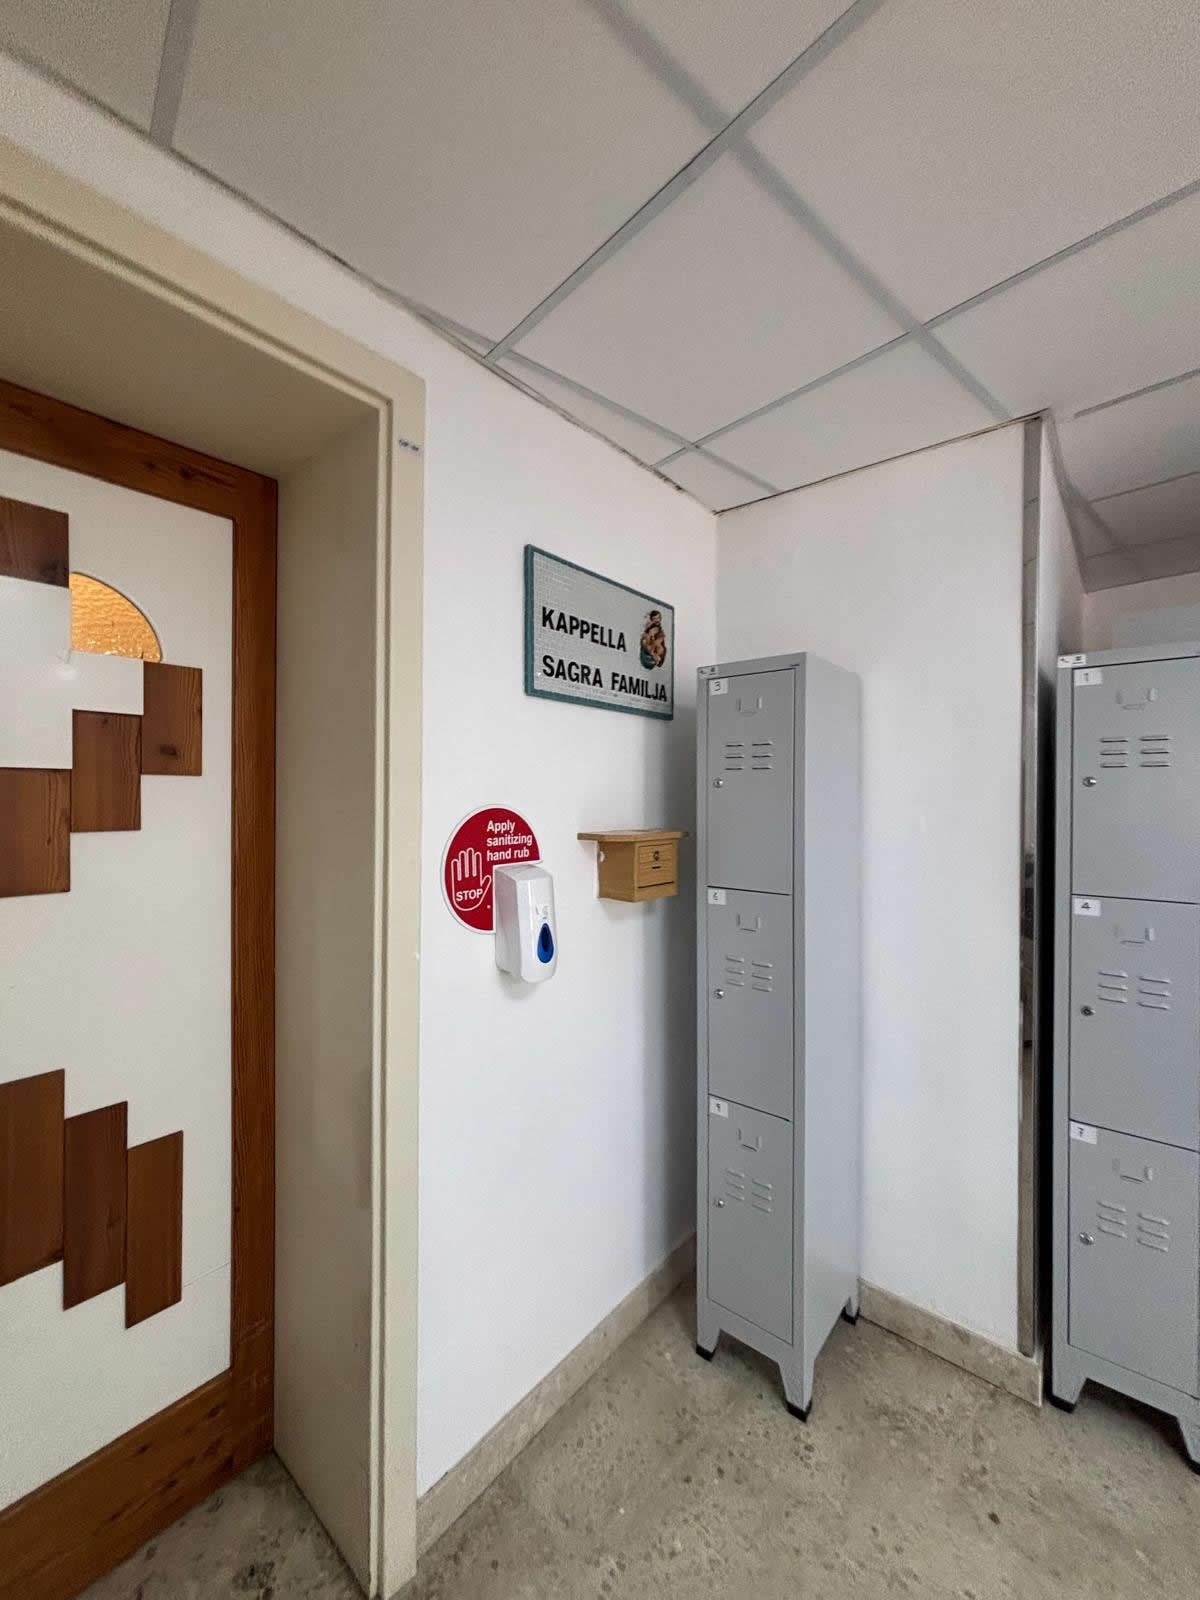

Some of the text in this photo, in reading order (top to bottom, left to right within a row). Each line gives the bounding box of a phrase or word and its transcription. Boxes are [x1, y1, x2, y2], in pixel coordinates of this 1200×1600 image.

[541, 606, 627, 653] KAPPELLA
[542, 654, 667, 702] SAGRA FAMILJA
[713, 681, 721, 692] 3
[486, 820, 516, 835] Apply
[486, 833, 533, 847] sanitizing
[486, 847, 530, 861] hand rub
[456, 888, 484, 902] STOP
[1080, 901, 1092, 911] 4
